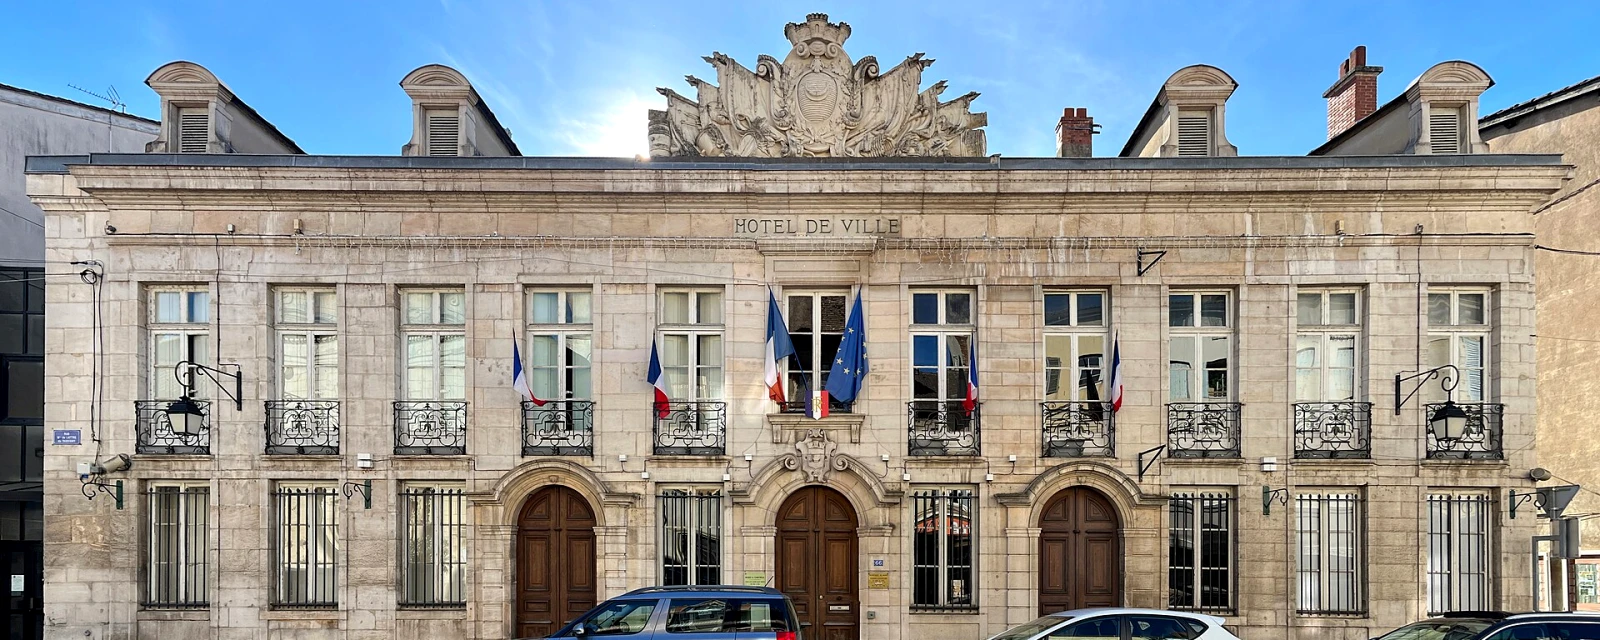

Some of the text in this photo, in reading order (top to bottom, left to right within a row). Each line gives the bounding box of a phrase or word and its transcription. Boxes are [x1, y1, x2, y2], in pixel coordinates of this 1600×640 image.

[734, 218, 900, 234] HOTEL DE VILLE
